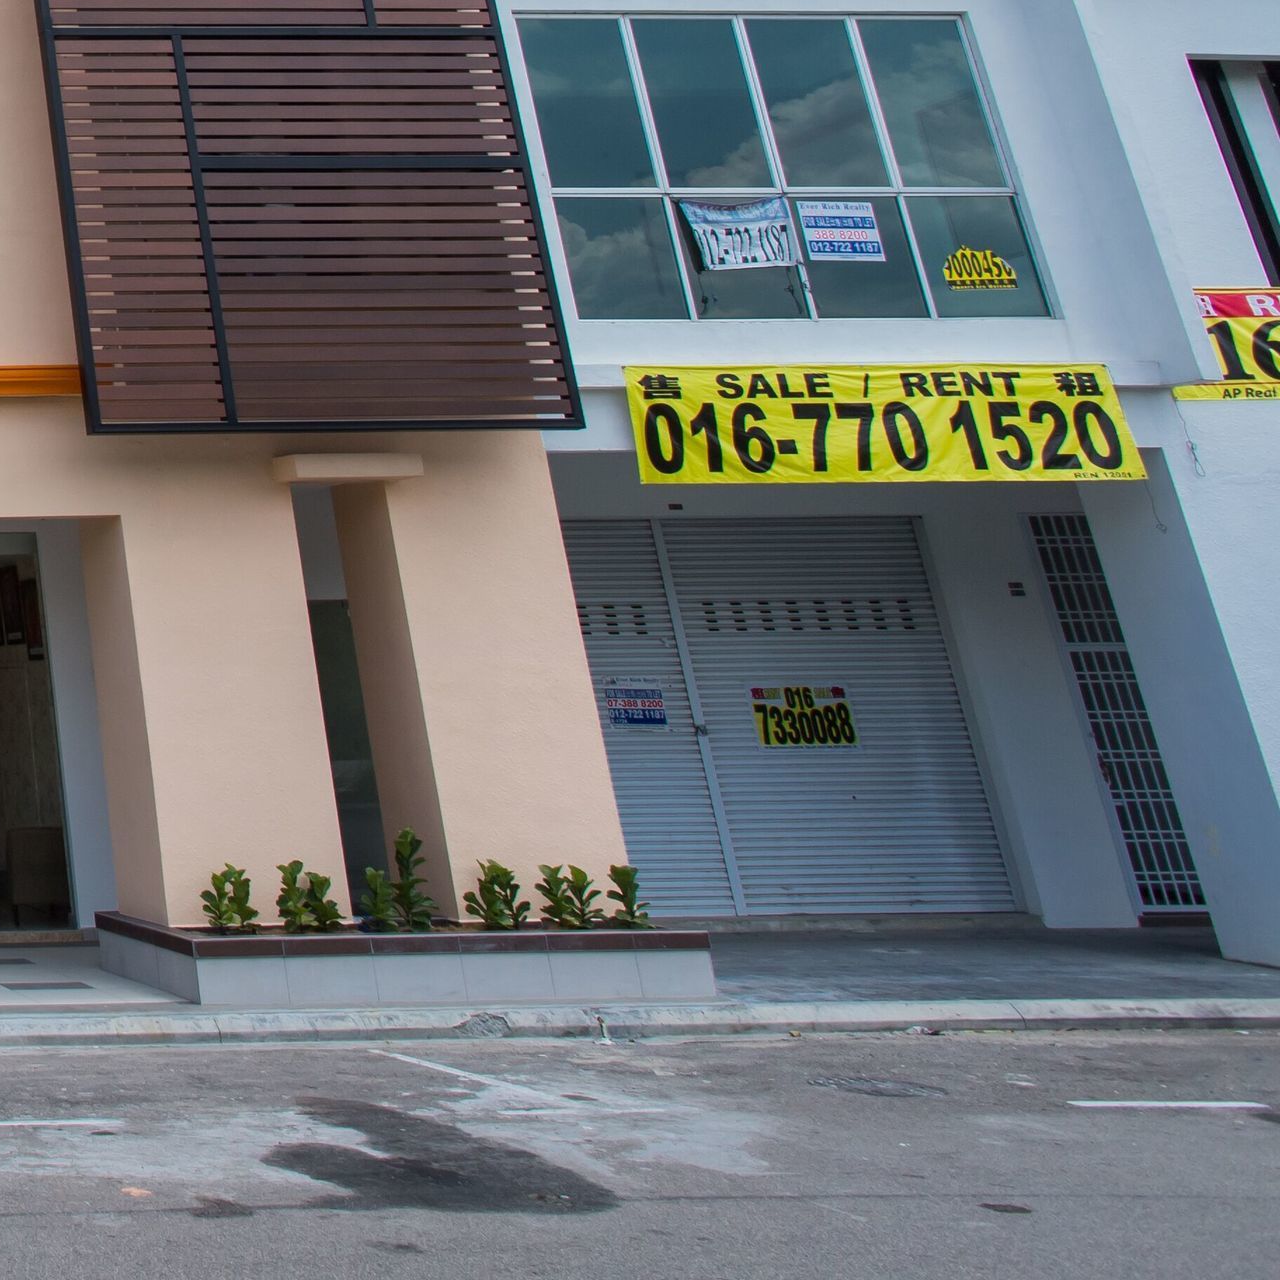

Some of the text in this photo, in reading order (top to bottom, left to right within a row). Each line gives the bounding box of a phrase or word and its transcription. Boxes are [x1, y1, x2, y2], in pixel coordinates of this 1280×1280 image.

[814, 230, 868, 240] 388 8200
[811, 242, 879, 252] 012-722 1187
[1245, 295, 1280, 316] R
[637, 374, 682, 400] 售
[715, 373, 834, 399] SALE
[899, 372, 1021, 397] RENT
[1052, 372, 1104, 397] 租
[1222, 388, 1241, 399] AP
[644, 400, 1123, 474] 016-770 1520
[607, 700, 663, 708] 07-388 8200
[784, 687, 815, 710] 016
[609, 709, 664, 719] 012-722 1187
[753, 702, 855, 745] 7330088
